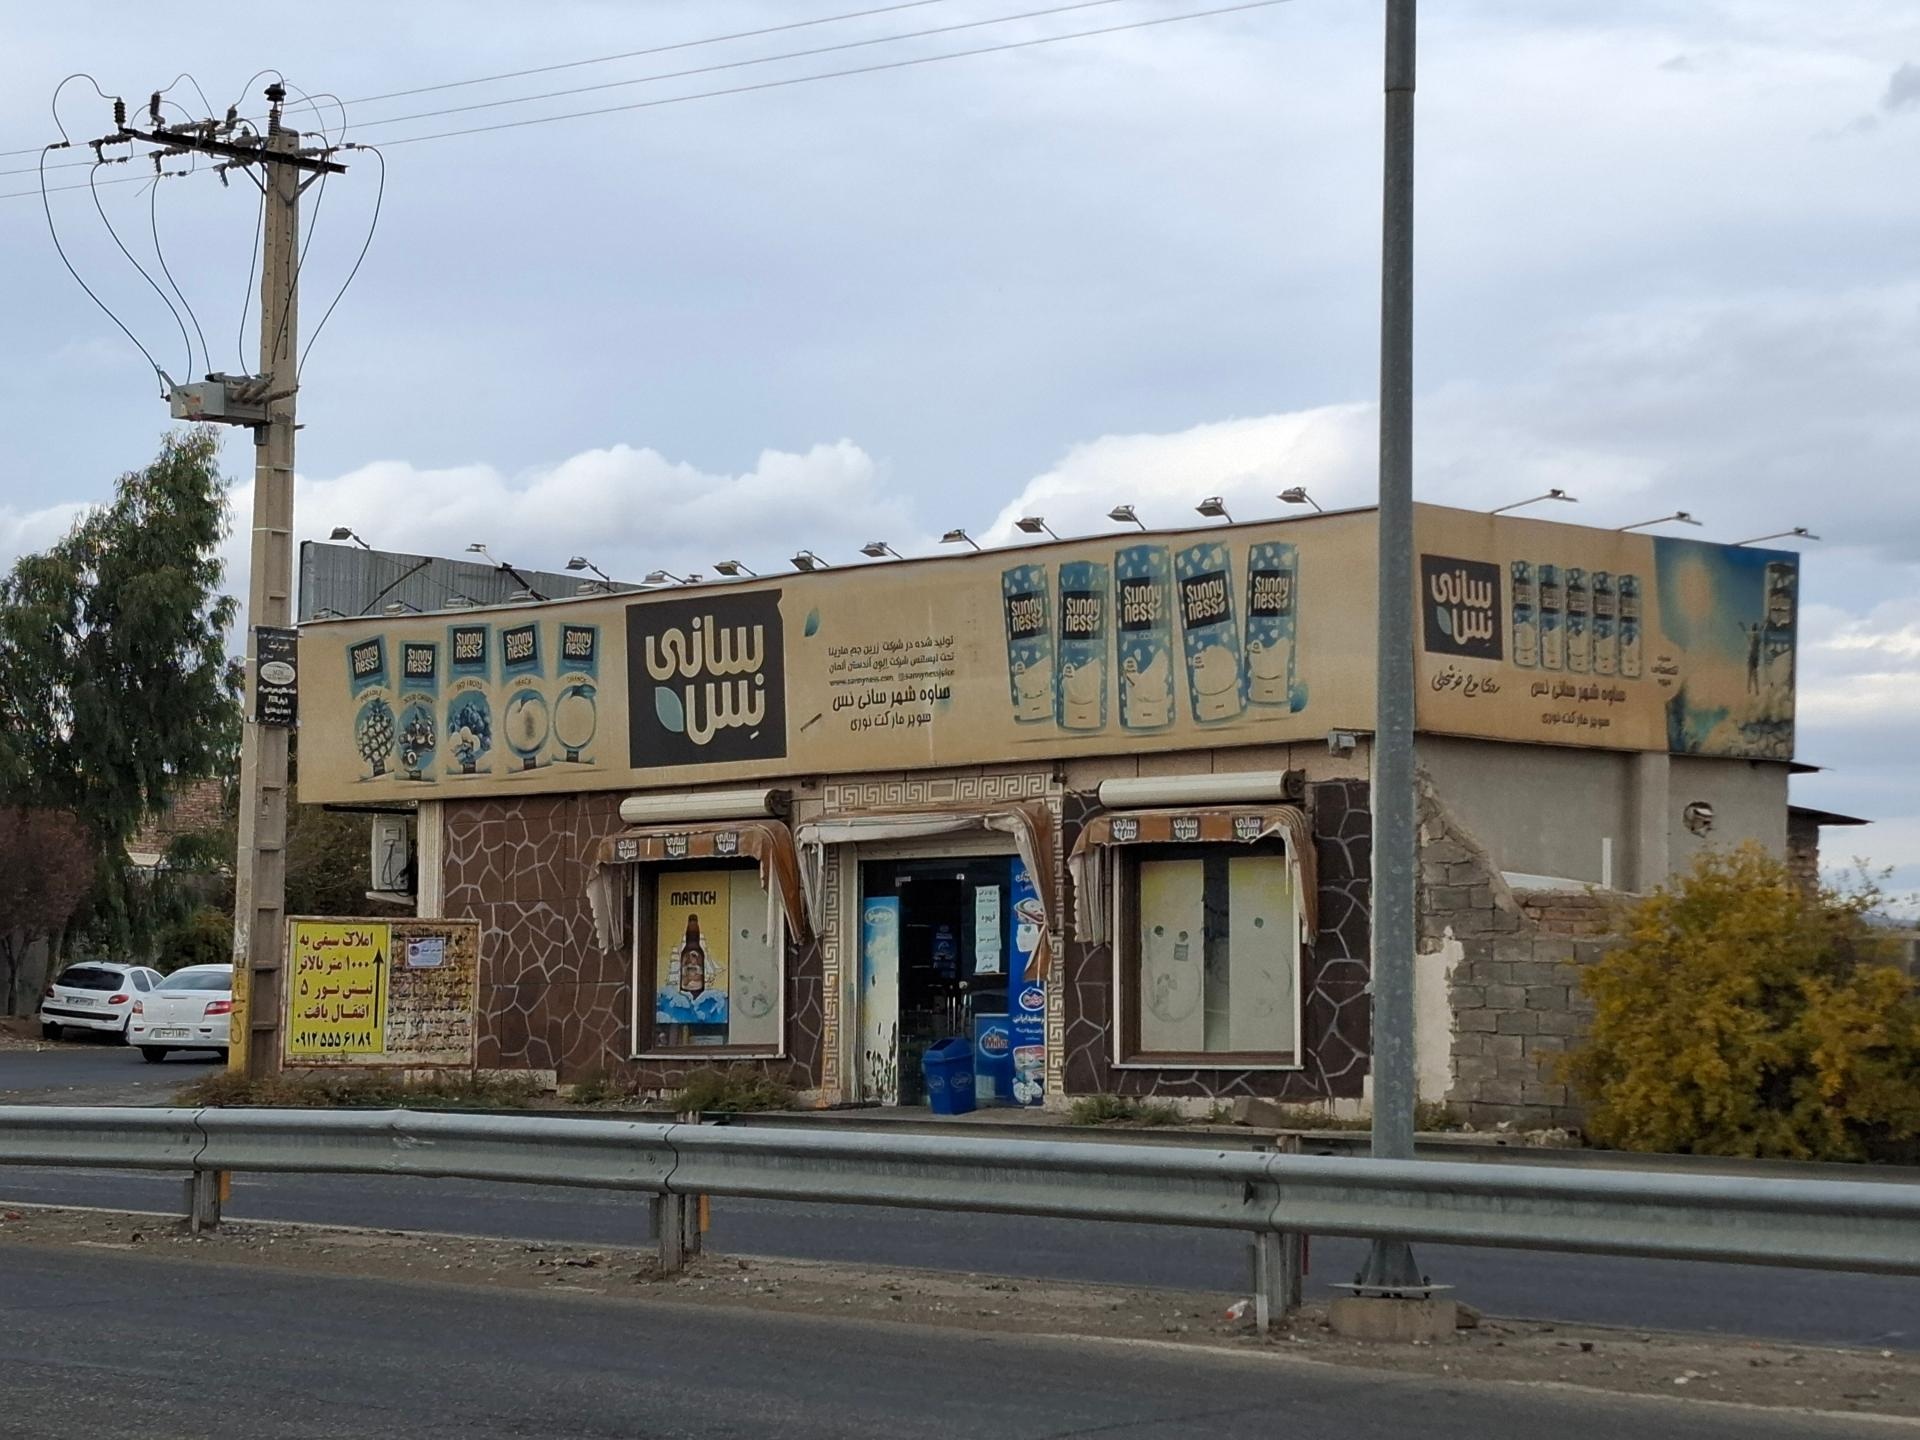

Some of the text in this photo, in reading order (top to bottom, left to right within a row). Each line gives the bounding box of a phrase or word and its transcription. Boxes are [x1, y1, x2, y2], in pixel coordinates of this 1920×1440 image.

[1124, 584, 1162, 605] sunny
[1187, 579, 1224, 602] sunny
[1255, 576, 1289, 597] sunny
[1430, 570, 1492, 608] سانی
[1012, 598, 1042, 616] sunny
[1066, 598, 1100, 620] sunny
[1188, 598, 1218, 621] ness
[1254, 592, 1282, 609] ness
[1125, 602, 1154, 623] ness
[1012, 614, 1038, 632] ness
[1066, 614, 1093, 632] ness
[456, 632, 482, 650] sunny
[507, 631, 532, 648] sunny
[566, 630, 592, 647] sunny
[905, 642, 914, 652] در
[456, 645, 477, 658] ness
[508, 645, 529, 659] ness
[566, 643, 586, 656] ness
[646, 616, 764, 680] سانی
[832, 684, 950, 712] ساوه شهر سانی نس
[850, 714, 872, 732] نوری
[670, 891, 717, 906] MALTICH
[300, 934, 309, 950] به
[312, 932, 340, 951] سیفی
[342, 930, 373, 947] املاک
[298, 955, 323, 975] بالاتر
[326, 958, 342, 975] متر
[300, 978, 309, 996] ۵
[314, 980, 340, 1000] نور
[342, 980, 373, 999] نبش
[332, 1003, 370, 1023] انتقال
